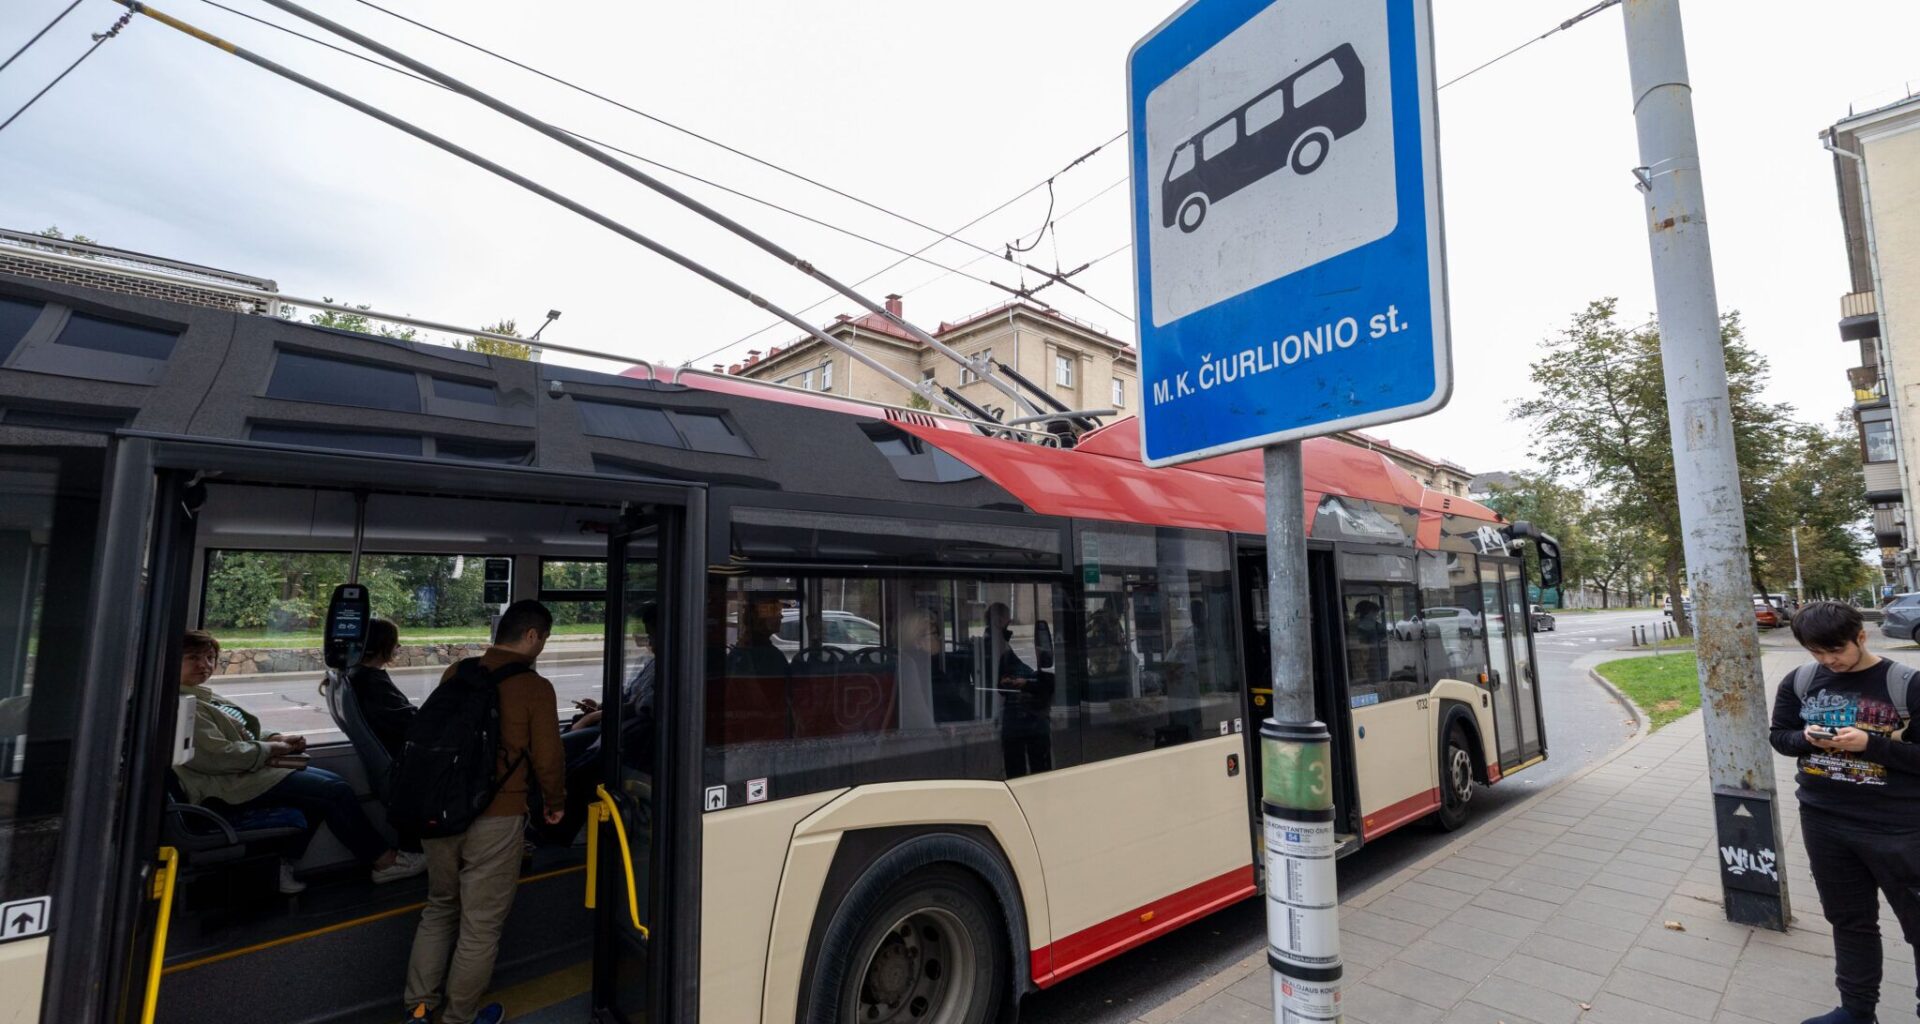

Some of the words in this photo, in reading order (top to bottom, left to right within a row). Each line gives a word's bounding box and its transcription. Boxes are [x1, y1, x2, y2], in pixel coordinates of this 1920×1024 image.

[1153, 379, 1174, 406] M.
[1176, 371, 1195, 398] K.
[1198, 317, 1358, 390] ČIURLIONIO
[1369, 304, 1408, 340] st.
[1416, 698, 1428, 710] 1732
[1309, 761, 1326, 795] 3
